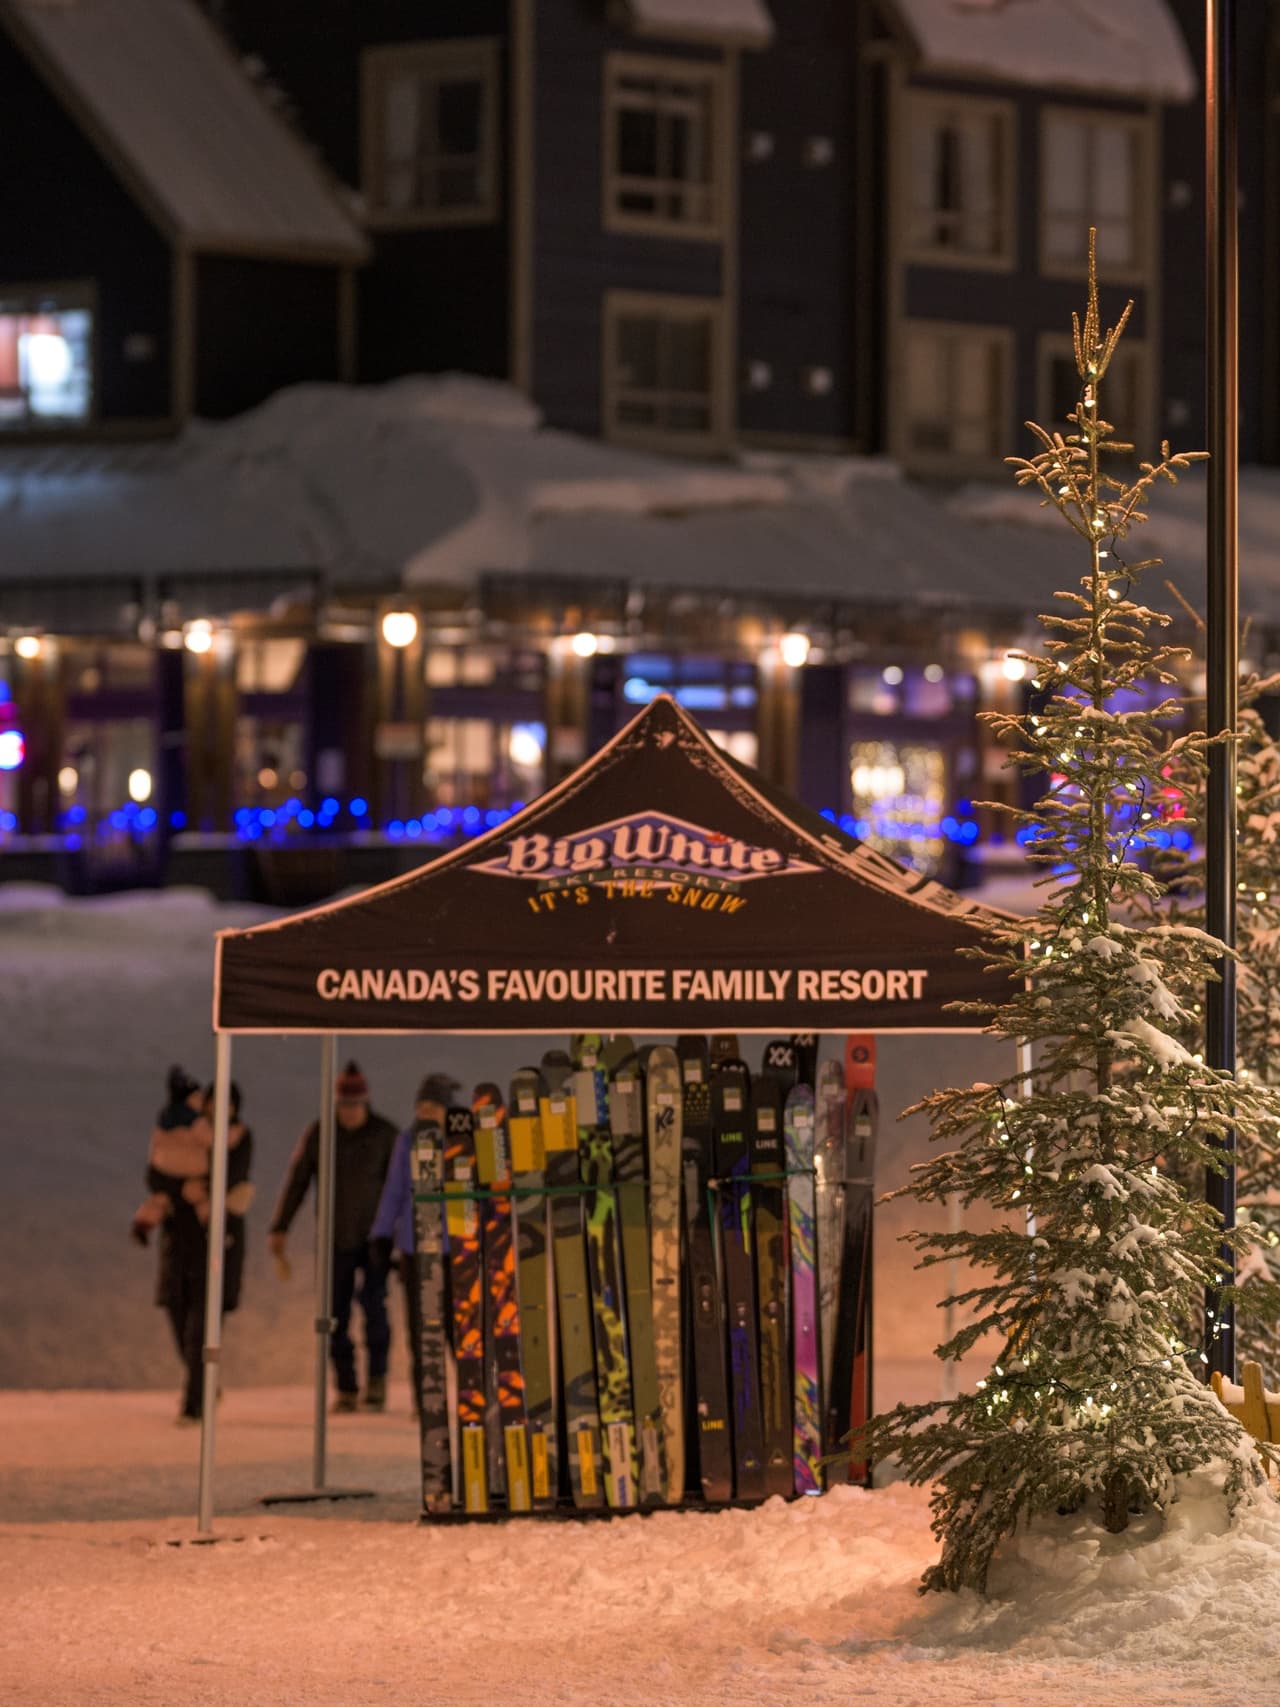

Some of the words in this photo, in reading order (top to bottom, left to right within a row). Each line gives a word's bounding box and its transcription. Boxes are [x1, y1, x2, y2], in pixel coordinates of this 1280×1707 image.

[507, 833, 608, 873] Big
[611, 823, 783, 873] White
[548, 871, 596, 889] SKI
[612, 867, 733, 891] RESORT
[526, 885, 592, 914] IT'S
[604, 879, 656, 899] THE
[666, 883, 749, 915] SNOW
[316, 968, 482, 1001] CANADA'S
[486, 969, 667, 1001] FAVOURITE
[672, 969, 793, 1001] FAMILY
[797, 969, 929, 1001] RESORT
[702, 1419, 724, 1431] LINE
